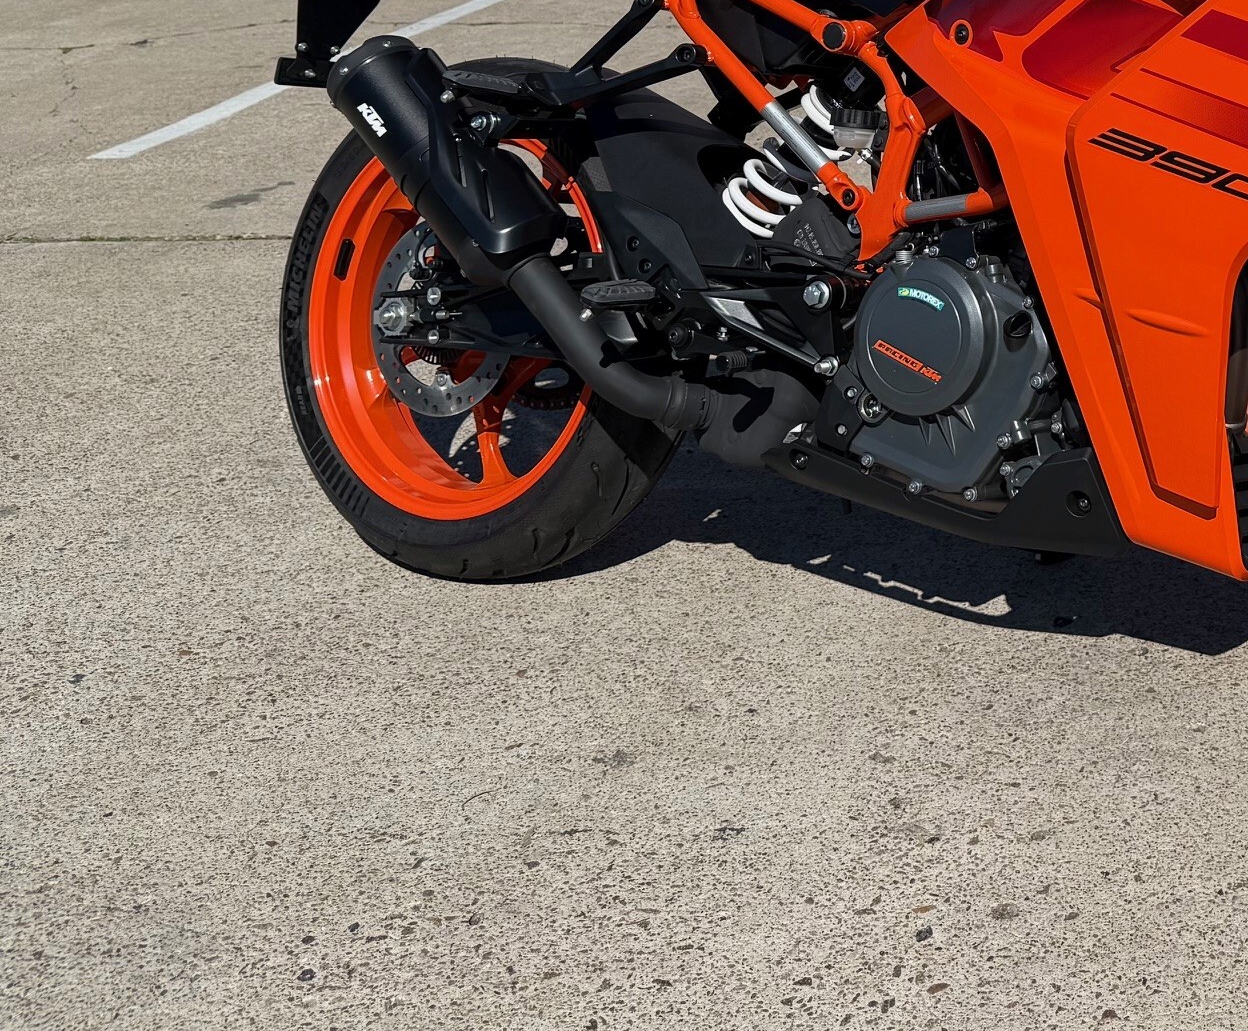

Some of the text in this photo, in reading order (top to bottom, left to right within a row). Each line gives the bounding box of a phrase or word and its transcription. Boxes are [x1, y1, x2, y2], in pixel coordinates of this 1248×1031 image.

[356, 102, 388, 138] KTM
[286, 203, 323, 313] MICHELIN
[908, 288, 943, 310] MOTOREX
[876, 342, 918, 369] RACING
